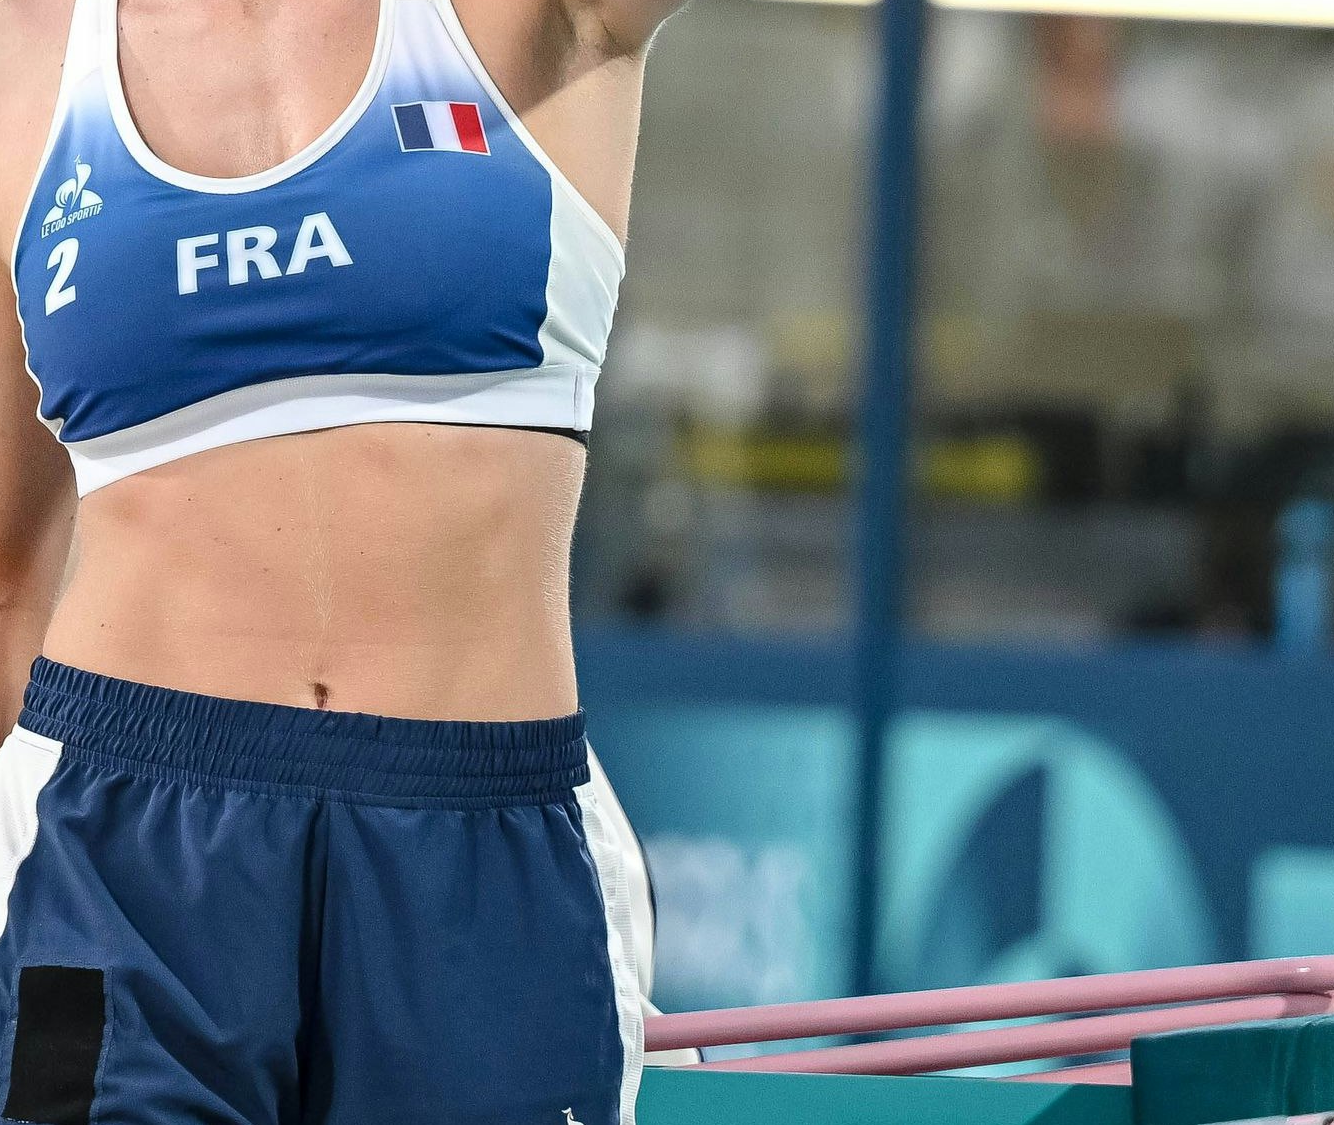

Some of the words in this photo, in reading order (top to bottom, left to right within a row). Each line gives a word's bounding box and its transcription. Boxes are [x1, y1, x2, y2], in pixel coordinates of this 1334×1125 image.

[41, 225, 50, 239] LE
[67, 203, 103, 226] SPORTIF
[176, 211, 354, 296] FRA
[44, 237, 80, 316] 2
